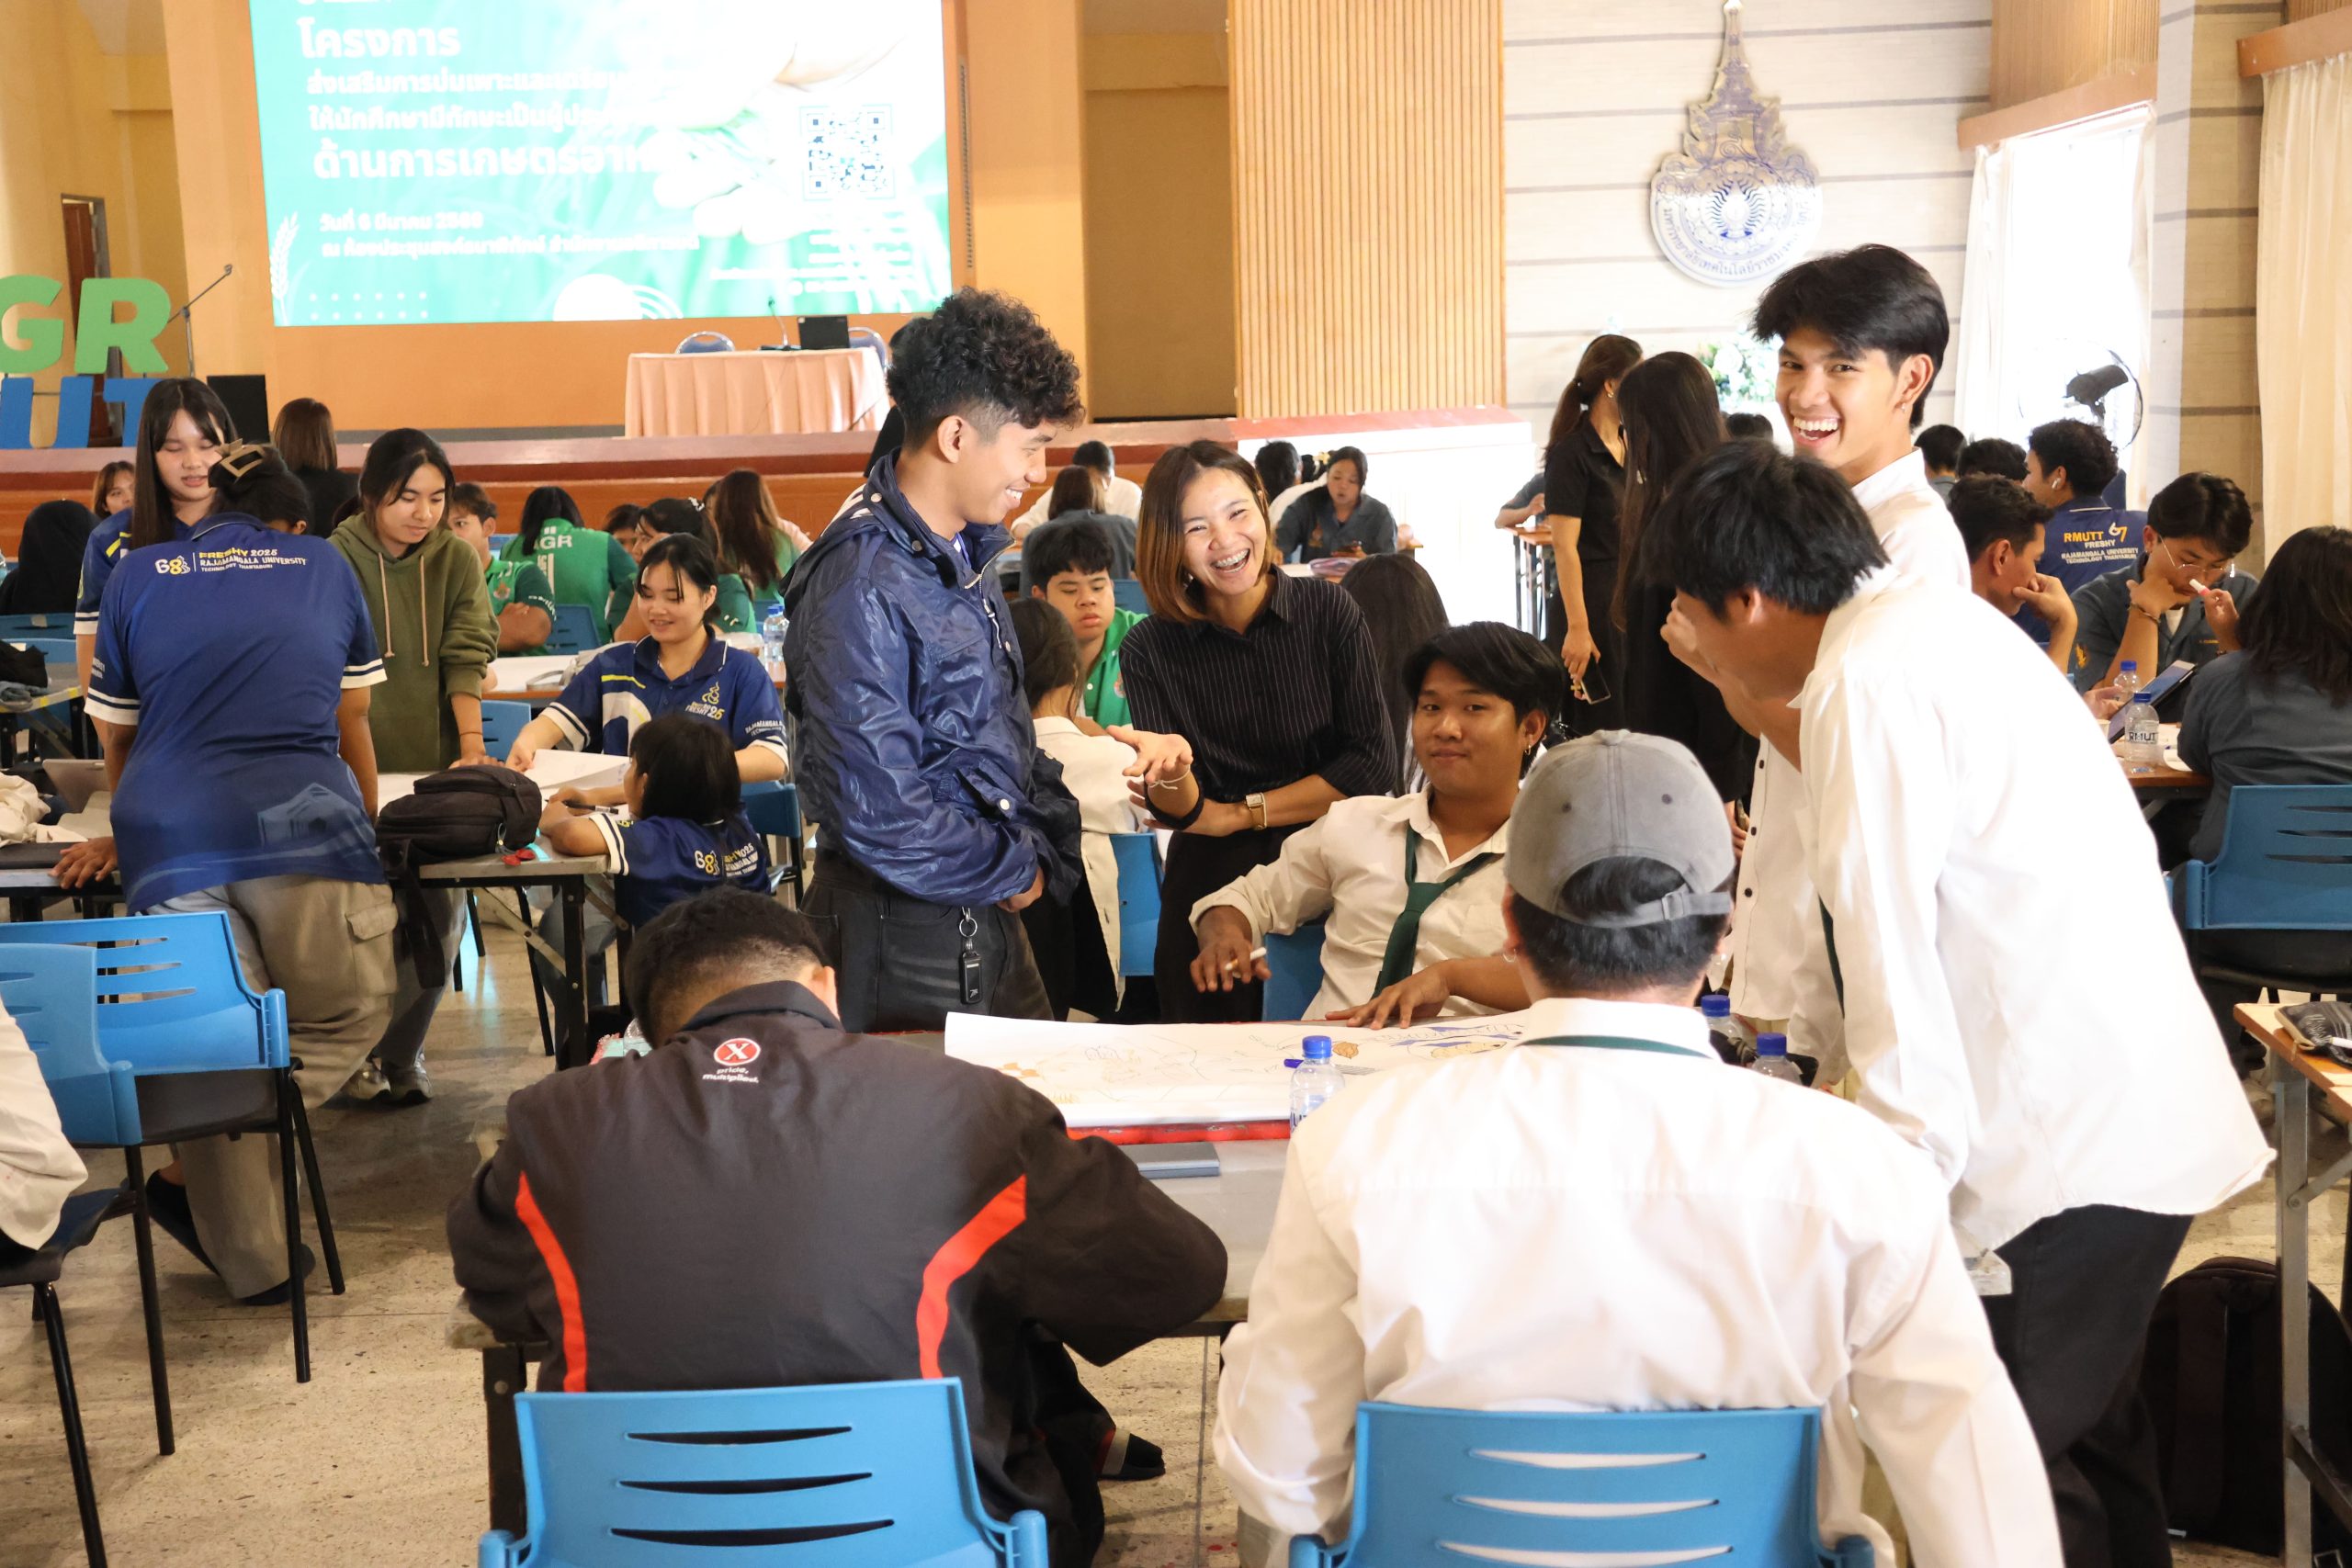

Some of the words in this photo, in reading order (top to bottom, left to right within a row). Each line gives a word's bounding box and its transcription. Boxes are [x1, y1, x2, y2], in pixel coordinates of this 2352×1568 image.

[297, 17, 461, 59] โครงการ
[2064, 531, 2104, 543] RMUTT
[2109, 522, 2128, 543] 67
[534, 535, 573, 549] GR
[2085, 539, 2116, 548] FRESHY
[198, 547, 249, 559] FRESHY
[250, 548, 278, 557] 2025
[199, 555, 259, 567] RAJAMANGALA
[262, 557, 308, 566] UNIVERSITY
[200, 563, 236, 572] TECHNOLOGY
[707, 705, 725, 720] 25
[694, 850, 715, 874] 68
[702, 1073, 759, 1084] multiplied.
